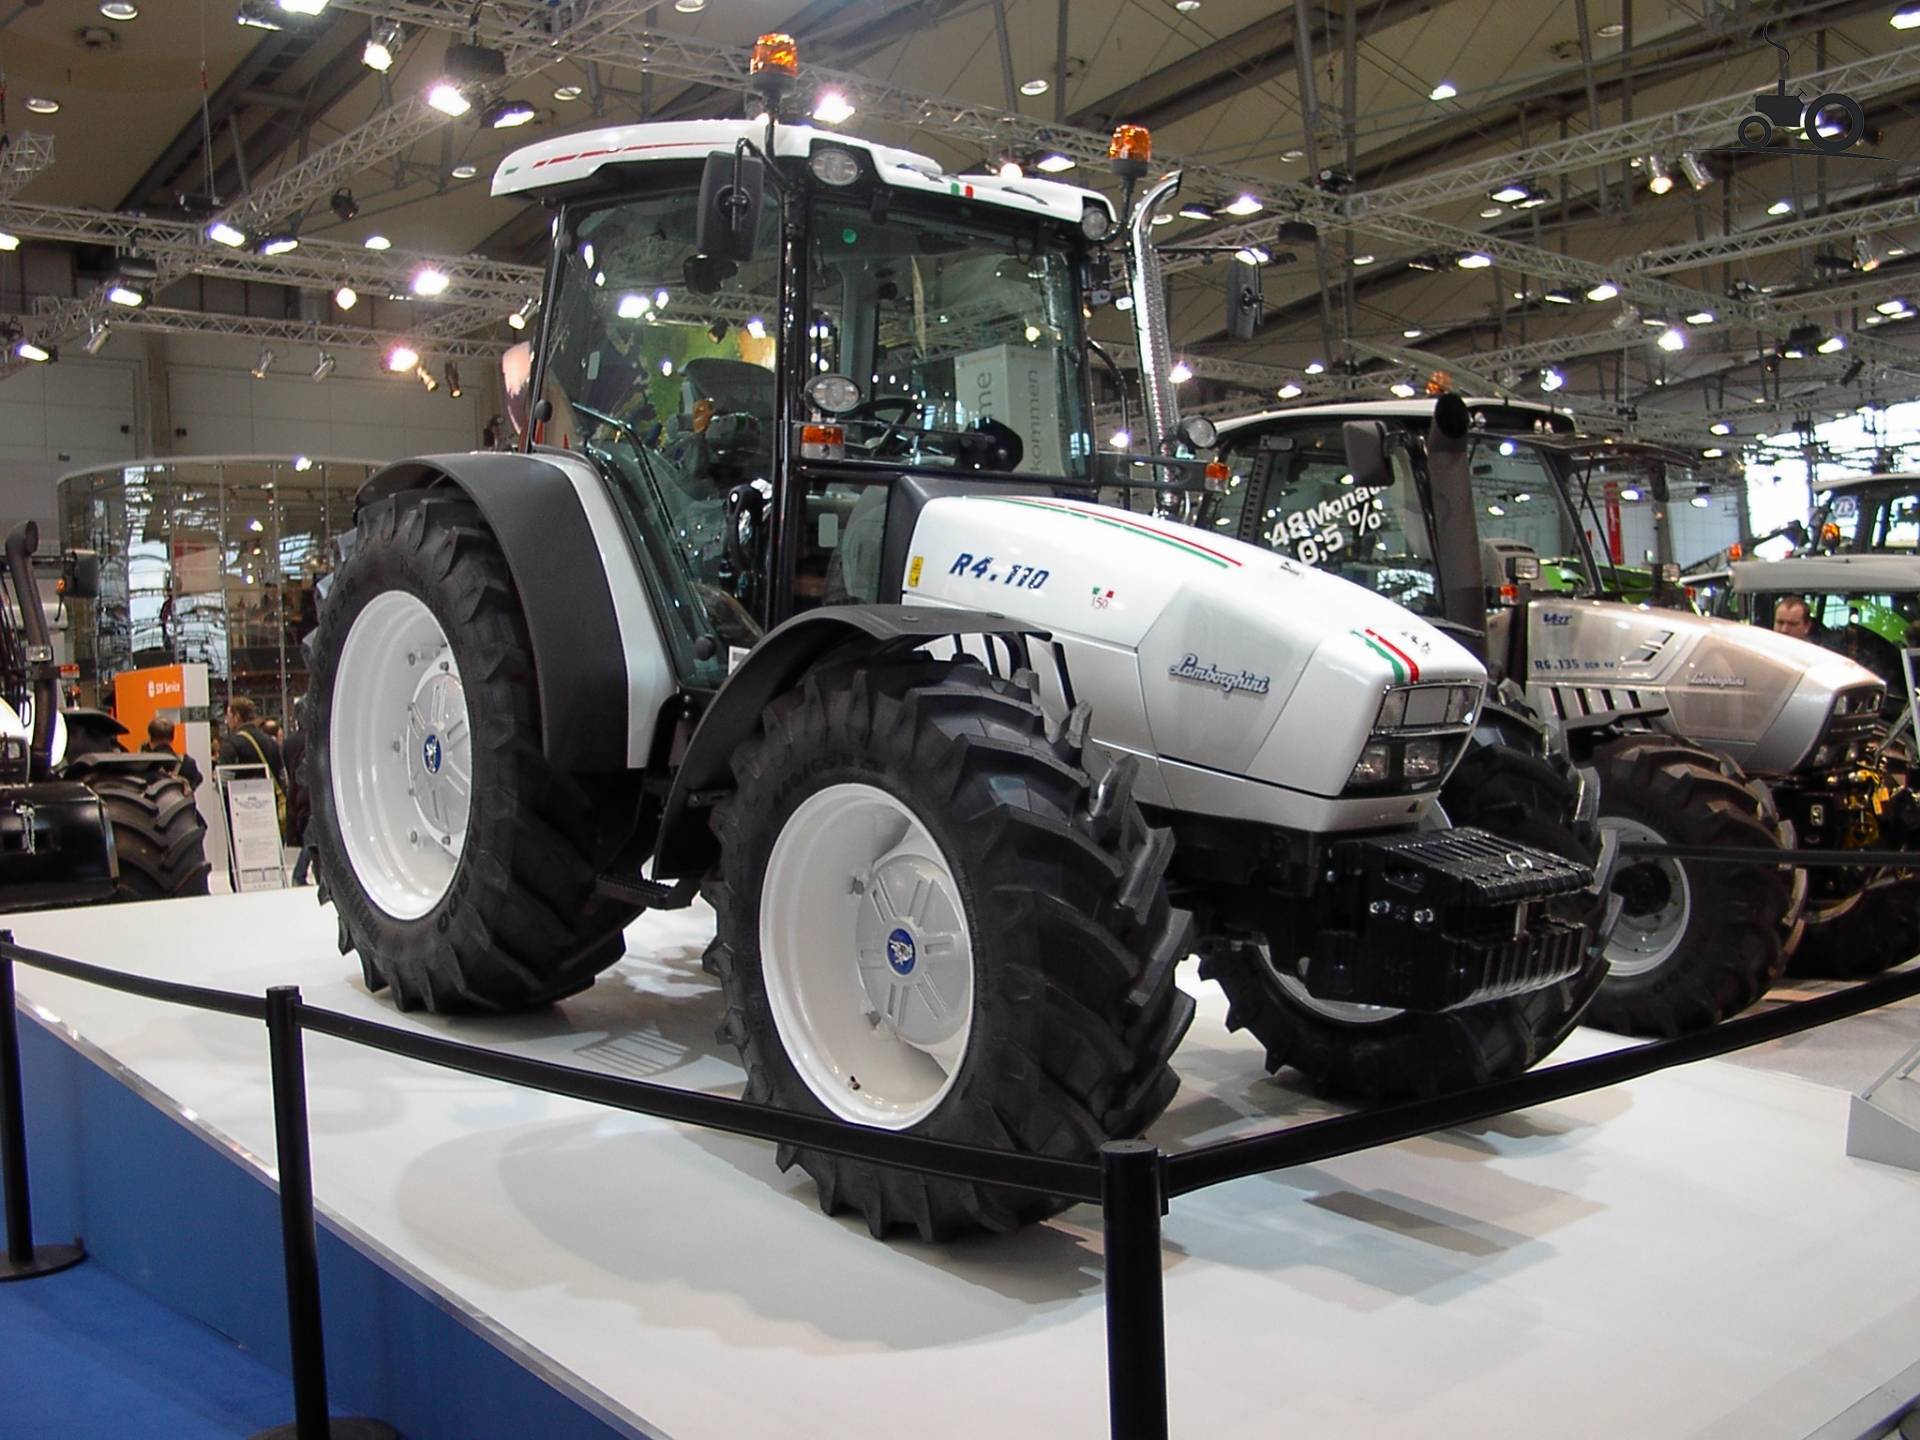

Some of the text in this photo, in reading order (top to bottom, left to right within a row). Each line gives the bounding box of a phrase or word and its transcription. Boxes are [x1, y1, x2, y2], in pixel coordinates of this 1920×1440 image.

[1306, 486, 1388, 529] Mona
[1297, 501, 1381, 565] 0,5 %
[949, 552, 1050, 590] R4.110
[1168, 653, 1271, 694] Lamborghini
